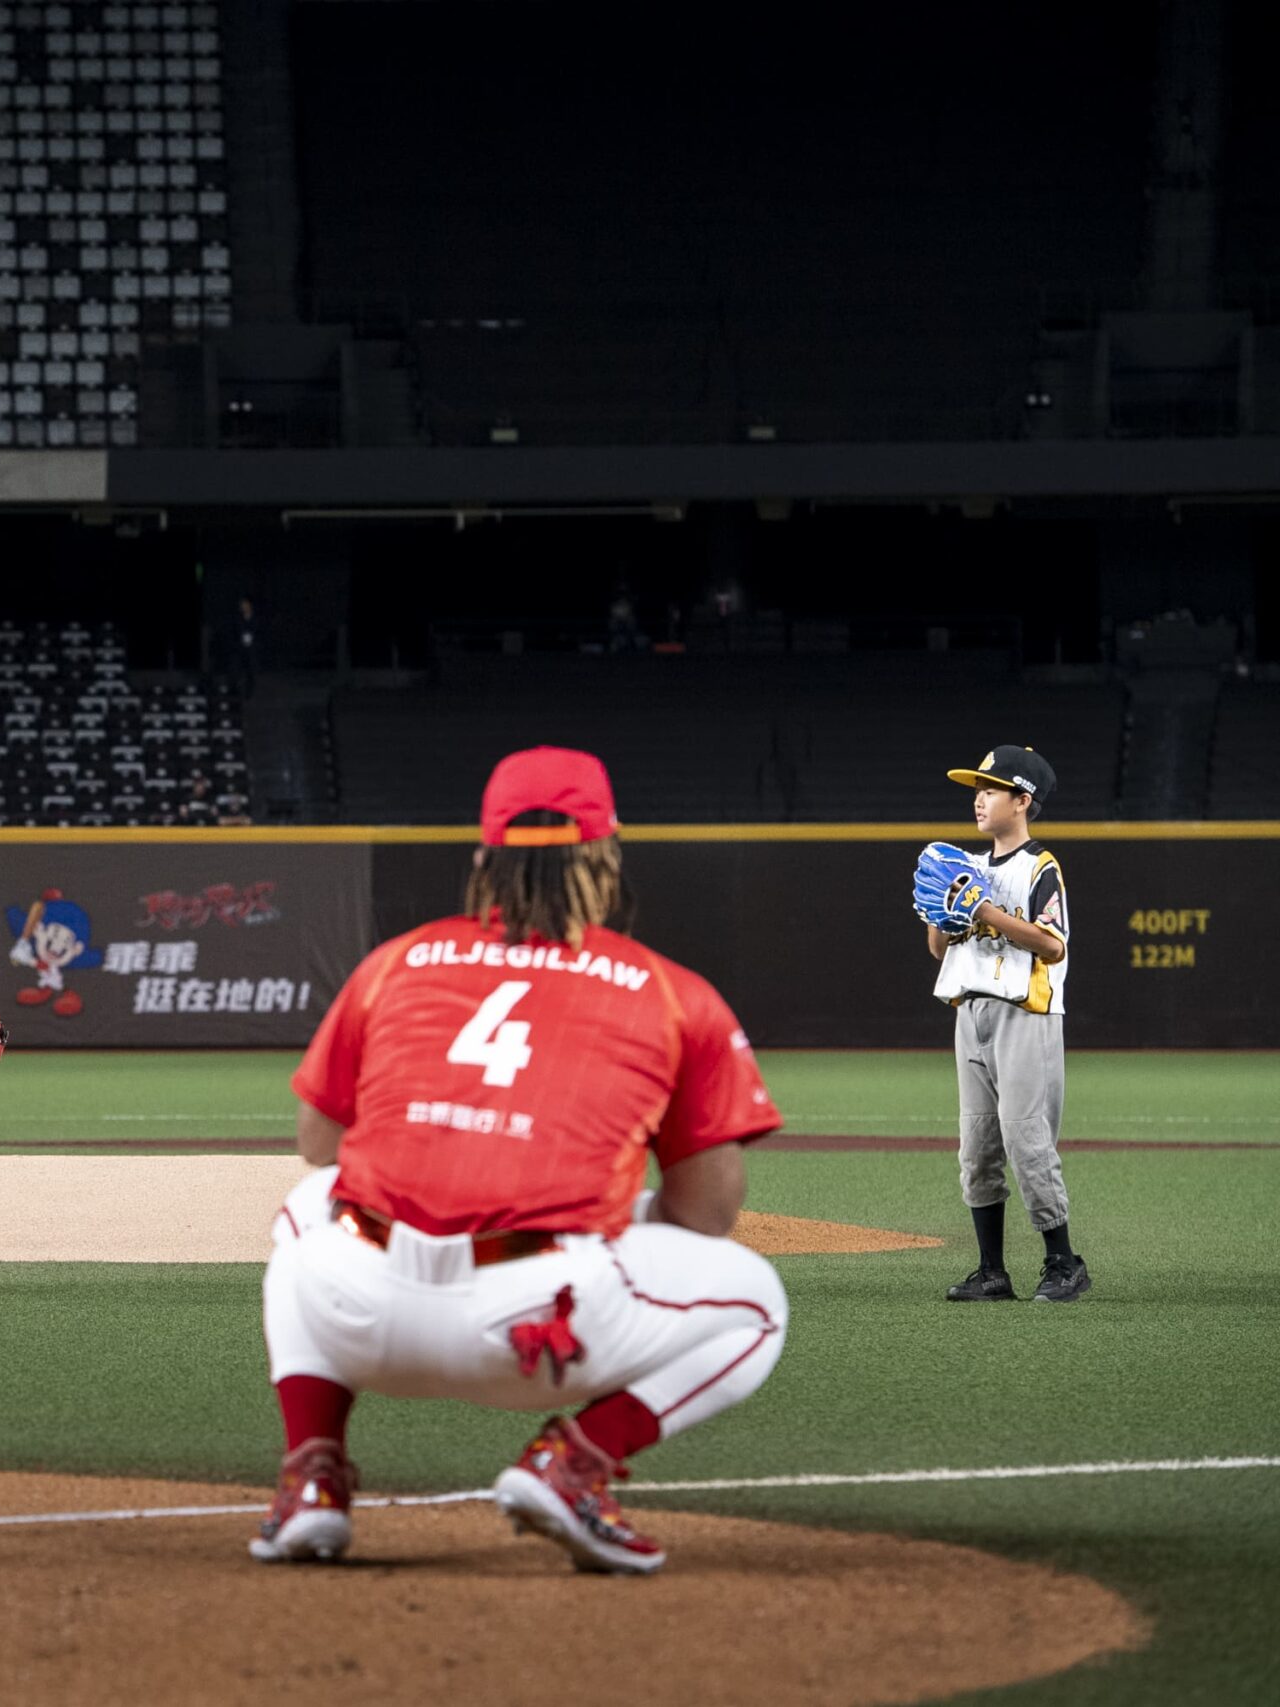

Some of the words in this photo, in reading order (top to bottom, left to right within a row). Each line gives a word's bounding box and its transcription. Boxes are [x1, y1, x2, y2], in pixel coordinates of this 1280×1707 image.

[1128, 909, 1212, 934] 400FT
[405, 939, 651, 991] GILJEGILJAW
[1131, 945, 1195, 968] 122M
[446, 980, 533, 1087] 4
